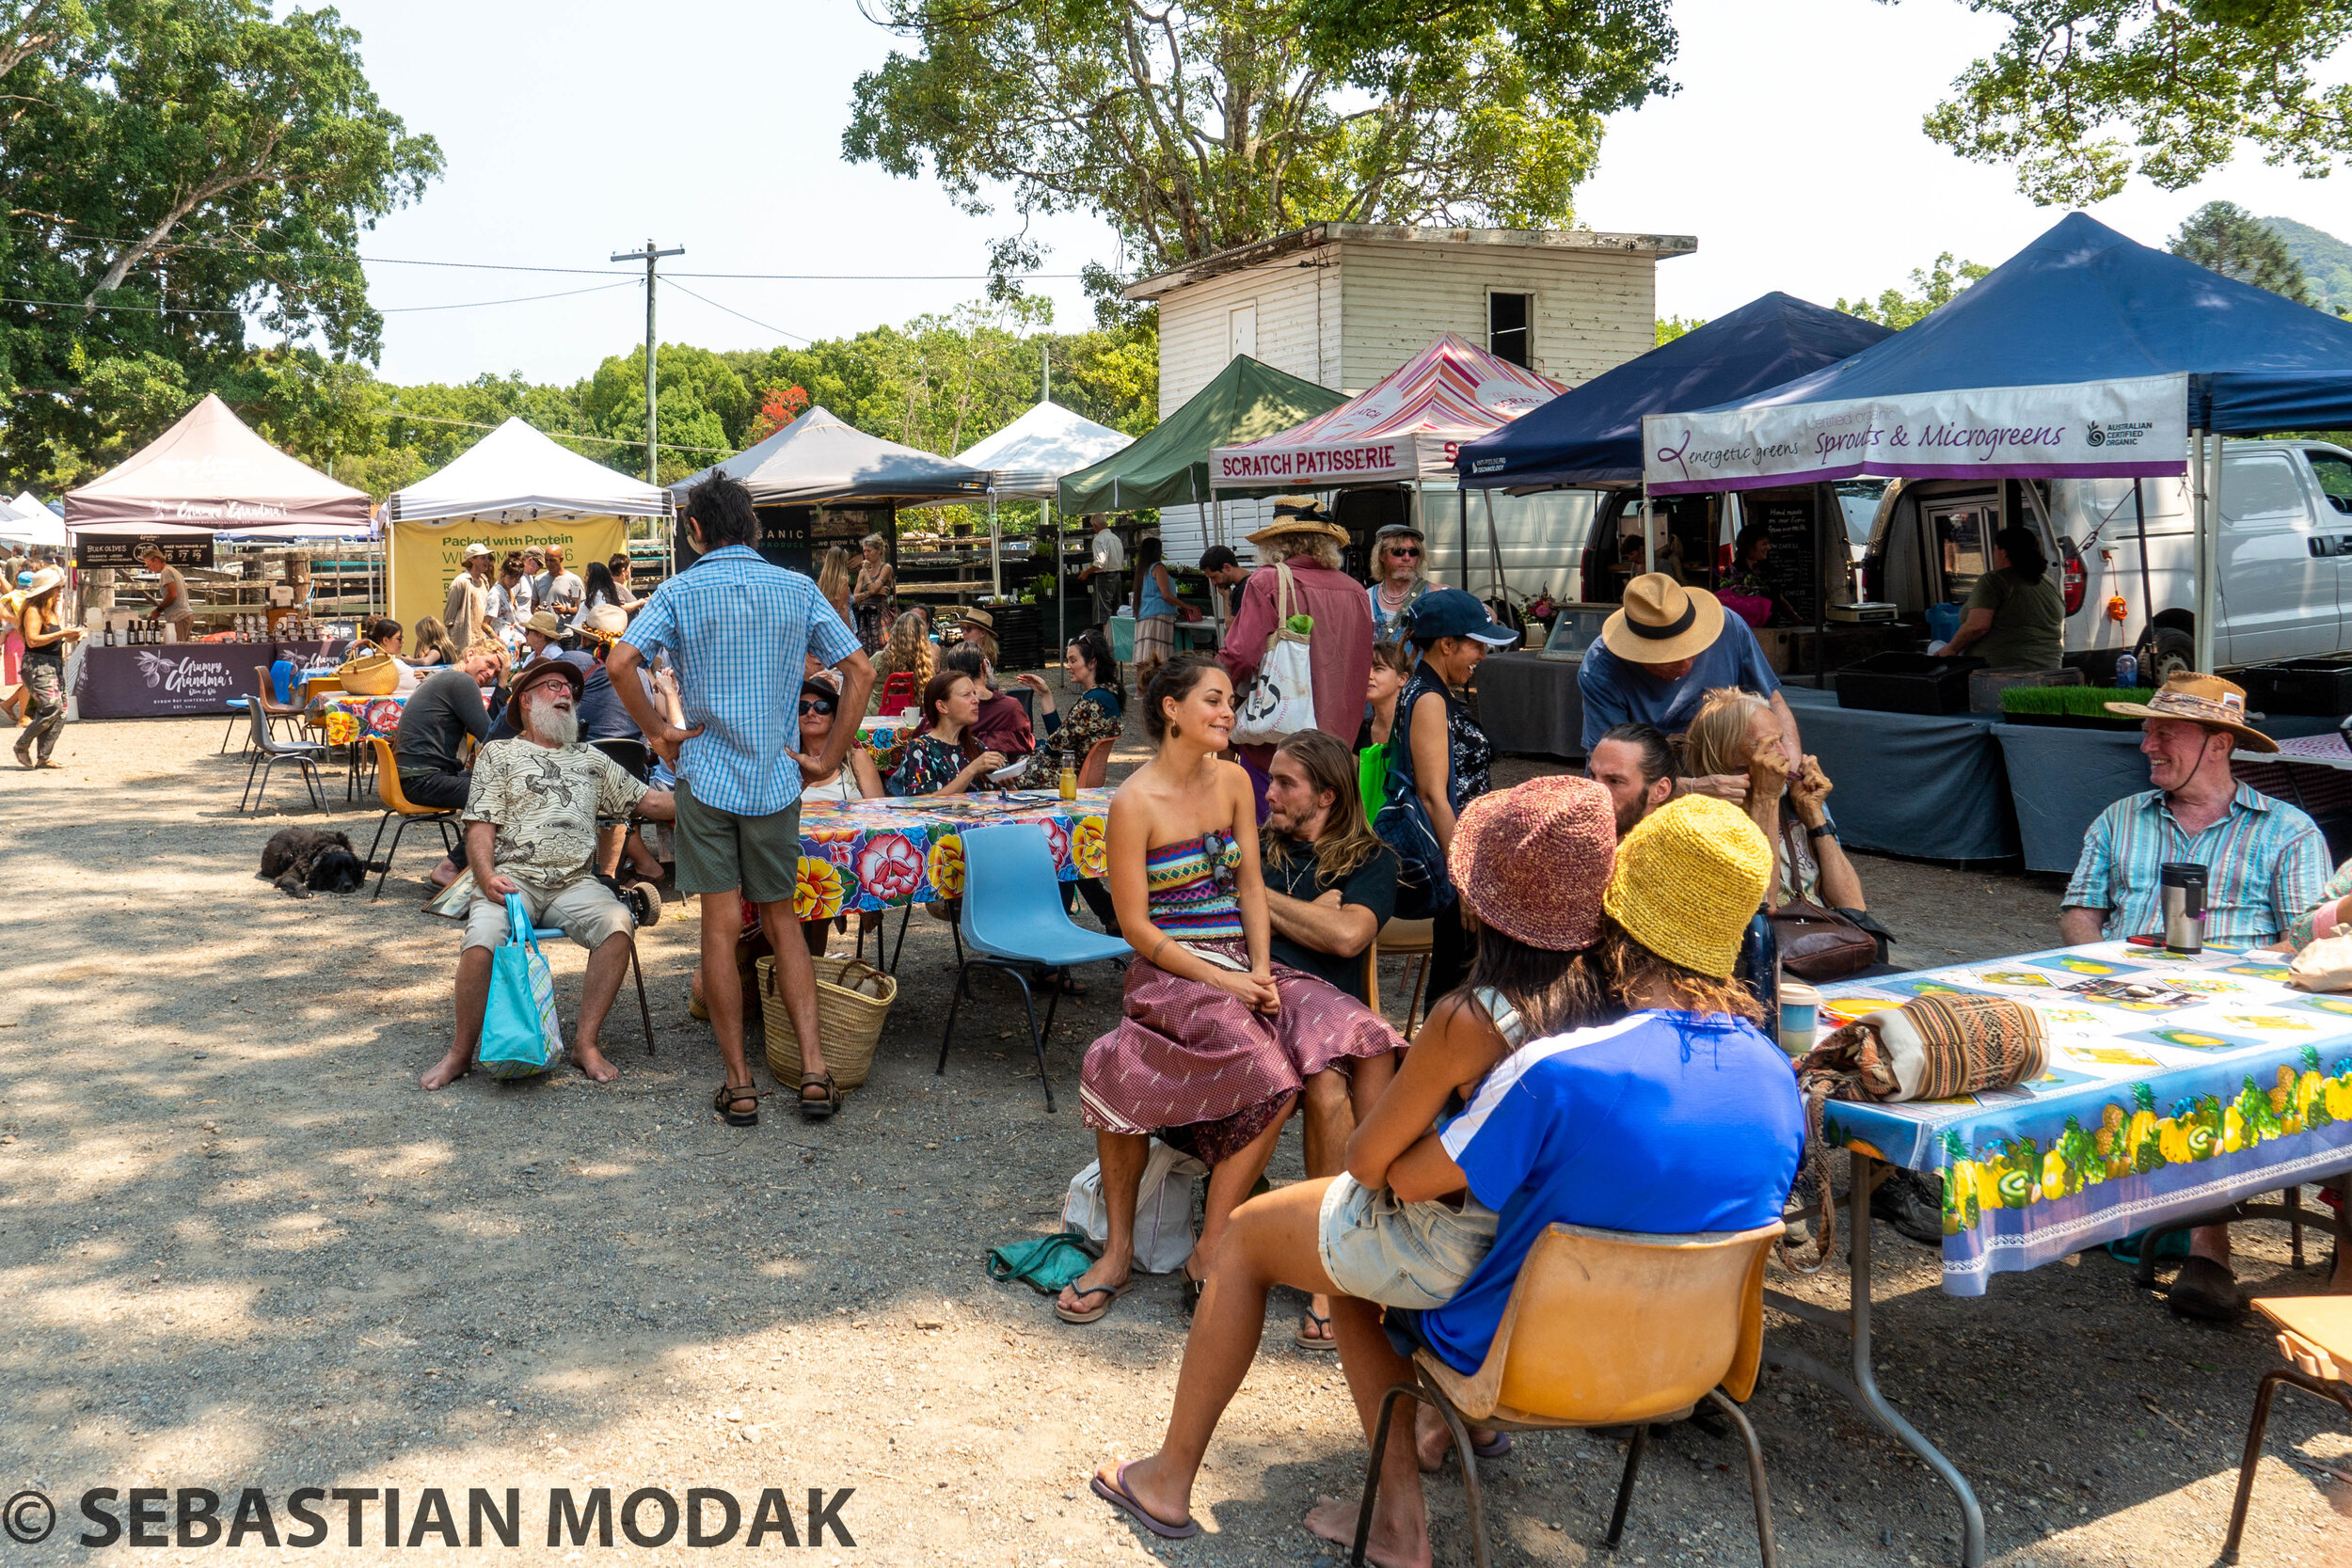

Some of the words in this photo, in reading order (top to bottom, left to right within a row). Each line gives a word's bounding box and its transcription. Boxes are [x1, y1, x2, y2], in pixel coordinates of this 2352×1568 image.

[2107, 422, 2153, 431] AUSTRALIAN
[2107, 430, 2143, 438] CERTIFIED
[1815, 423, 1885, 465] Sprouts
[1889, 424, 1911, 447] &
[1917, 421, 2066, 462] Microgreens
[1222, 454, 1293, 477] SCRATCH
[1295, 445, 1397, 475] PATISSERIE
[1689, 443, 1751, 468] energetic
[1752, 442, 1799, 466] greens
[442, 536, 490, 546] Packed
[492, 536, 523, 546] with
[525, 534, 573, 546] Protein
[179, 657, 222, 676] Grumpy
[165, 669, 233, 693] Grandma's
